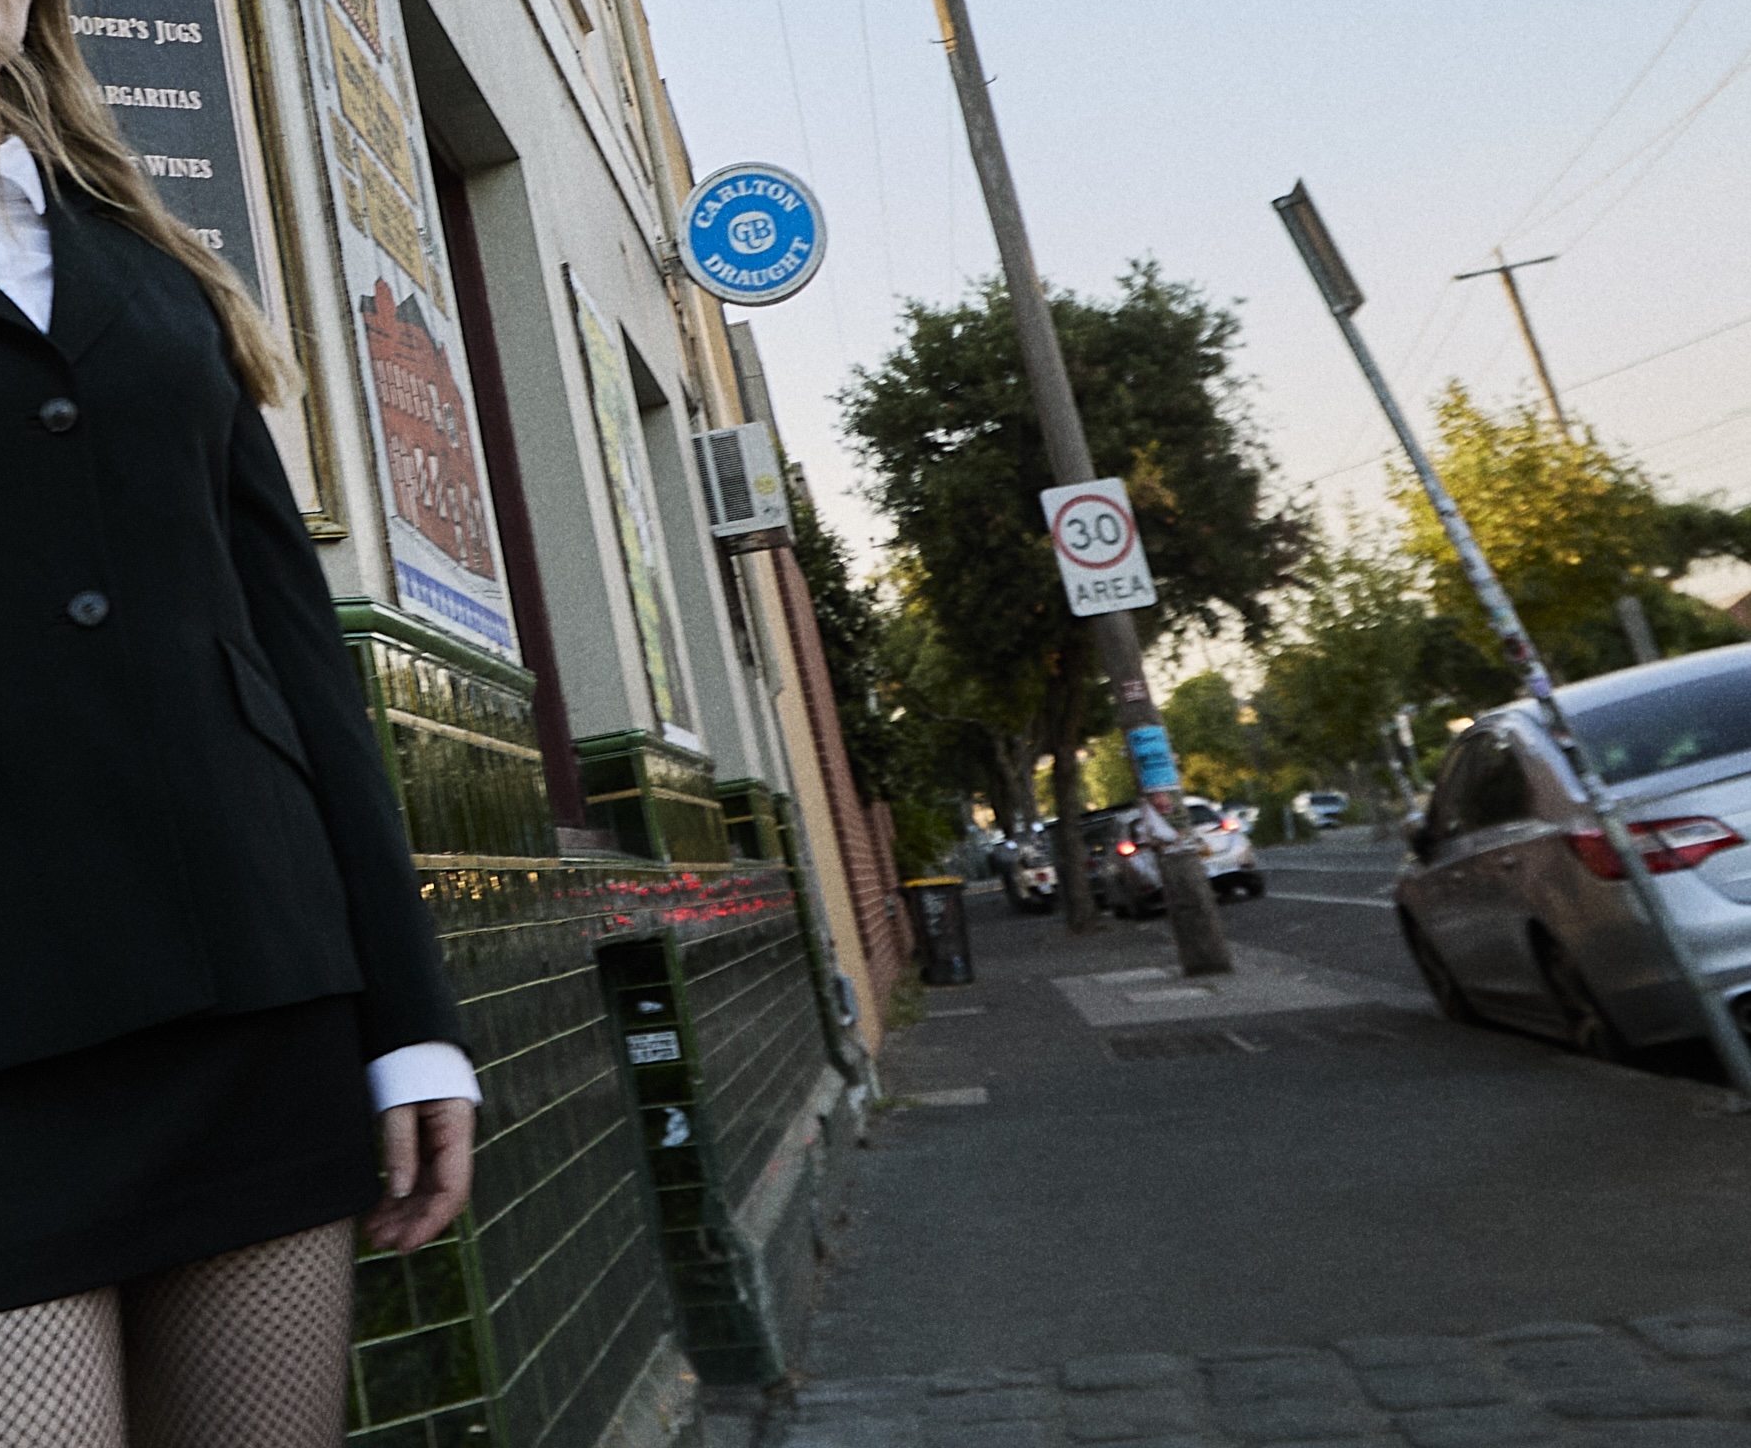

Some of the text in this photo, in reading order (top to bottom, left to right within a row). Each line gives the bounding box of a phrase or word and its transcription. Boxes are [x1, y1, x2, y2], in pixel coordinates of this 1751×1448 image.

[68, 15, 203, 45] OOPER'S JUGS
[97, 85, 203, 110] ARGARITAS
[143, 155, 214, 179] WINES
[694, 178, 803, 229] CARLTON
[703, 236, 811, 286] DRAUGHT
[1066, 513, 1121, 550] 30
[1076, 574, 1151, 605] AREA
